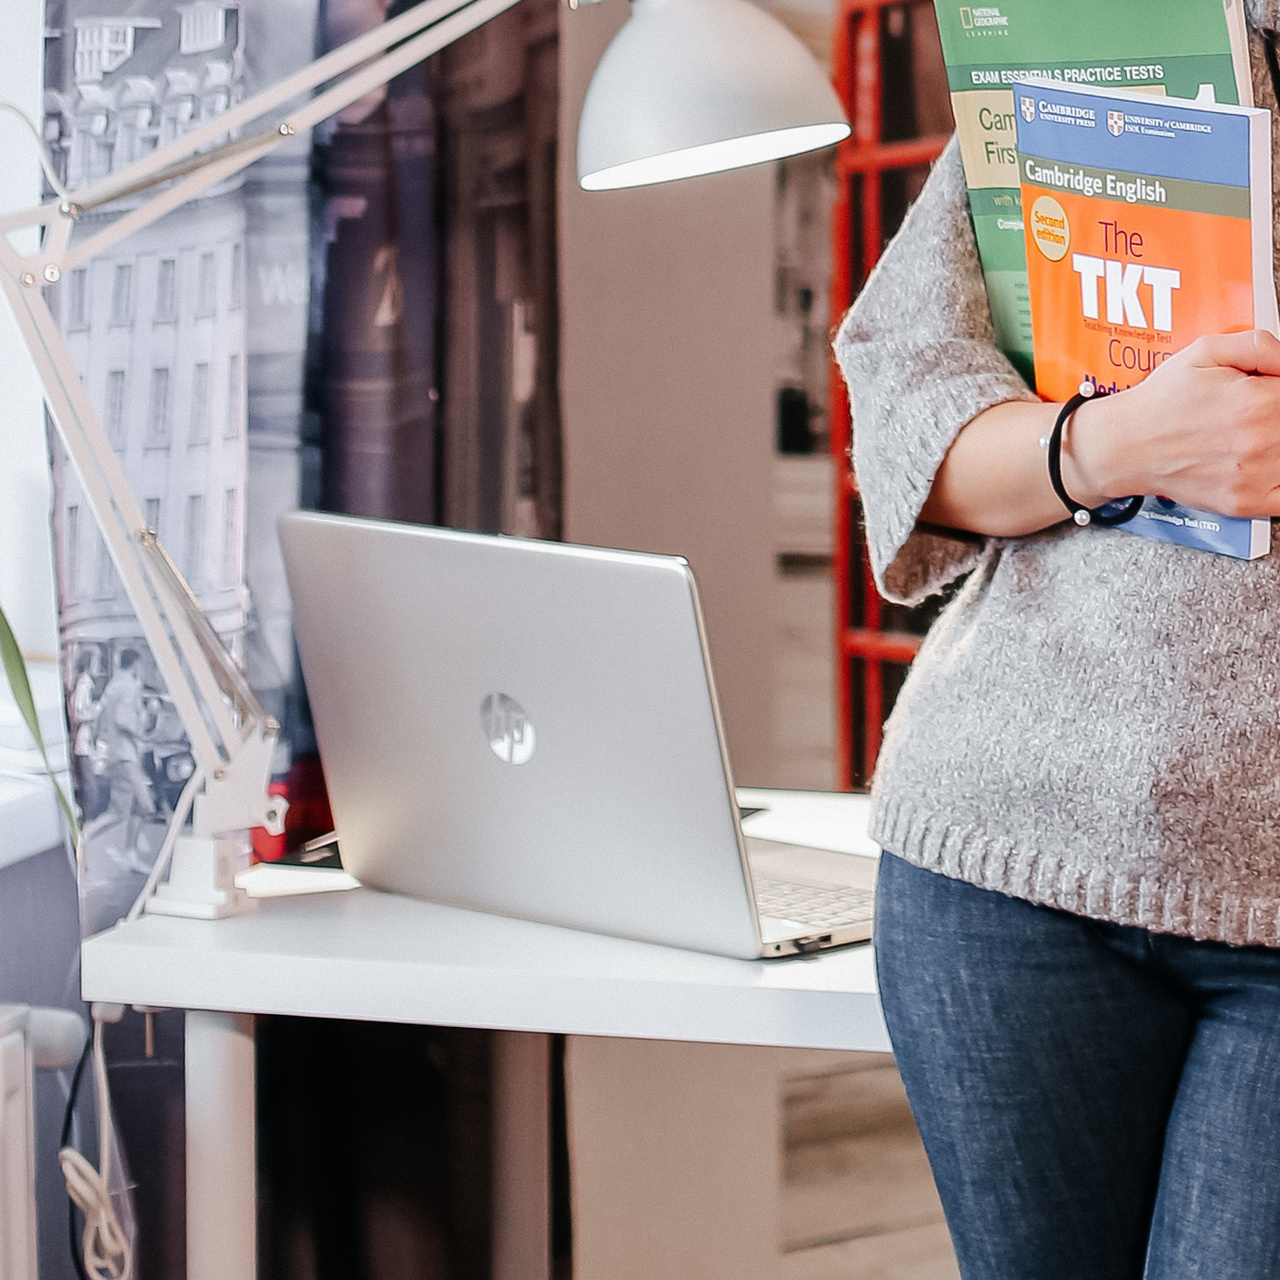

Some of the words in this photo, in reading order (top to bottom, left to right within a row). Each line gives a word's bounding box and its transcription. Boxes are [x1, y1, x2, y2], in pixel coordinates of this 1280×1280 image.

[972, 7, 1000, 17] NATIONAL
[974, 16, 1008, 26] GEOGRAPHIC
[970, 70, 1000, 85] EXAM
[1064, 66, 1122, 82] PRACTICE
[1124, 65, 1164, 80] TESTS
[1038, 101, 1096, 120] CAMBRIDGE
[1039, 113, 1076, 126] UNIVERSITY
[1076, 119, 1096, 127] PRESS
[1124, 115, 1163, 127] UNIVERSITY
[1170, 122, 1212, 134] CAMBRIDGE
[1025, 159, 1103, 197] Cambridge
[1106, 174, 1166, 203] English
[1034, 210, 1065, 230] Second
[1036, 228, 1066, 246] edition
[1098, 221, 1144, 258] The
[1072, 252, 1181, 333] TKT
[1084, 319, 1112, 337] Teaching
[1113, 327, 1155, 343] Knowledge
[1156, 332, 1172, 344] Test
[1199, 521, 1220, 532] (TKT)
[485, 692, 531, 765] hp
